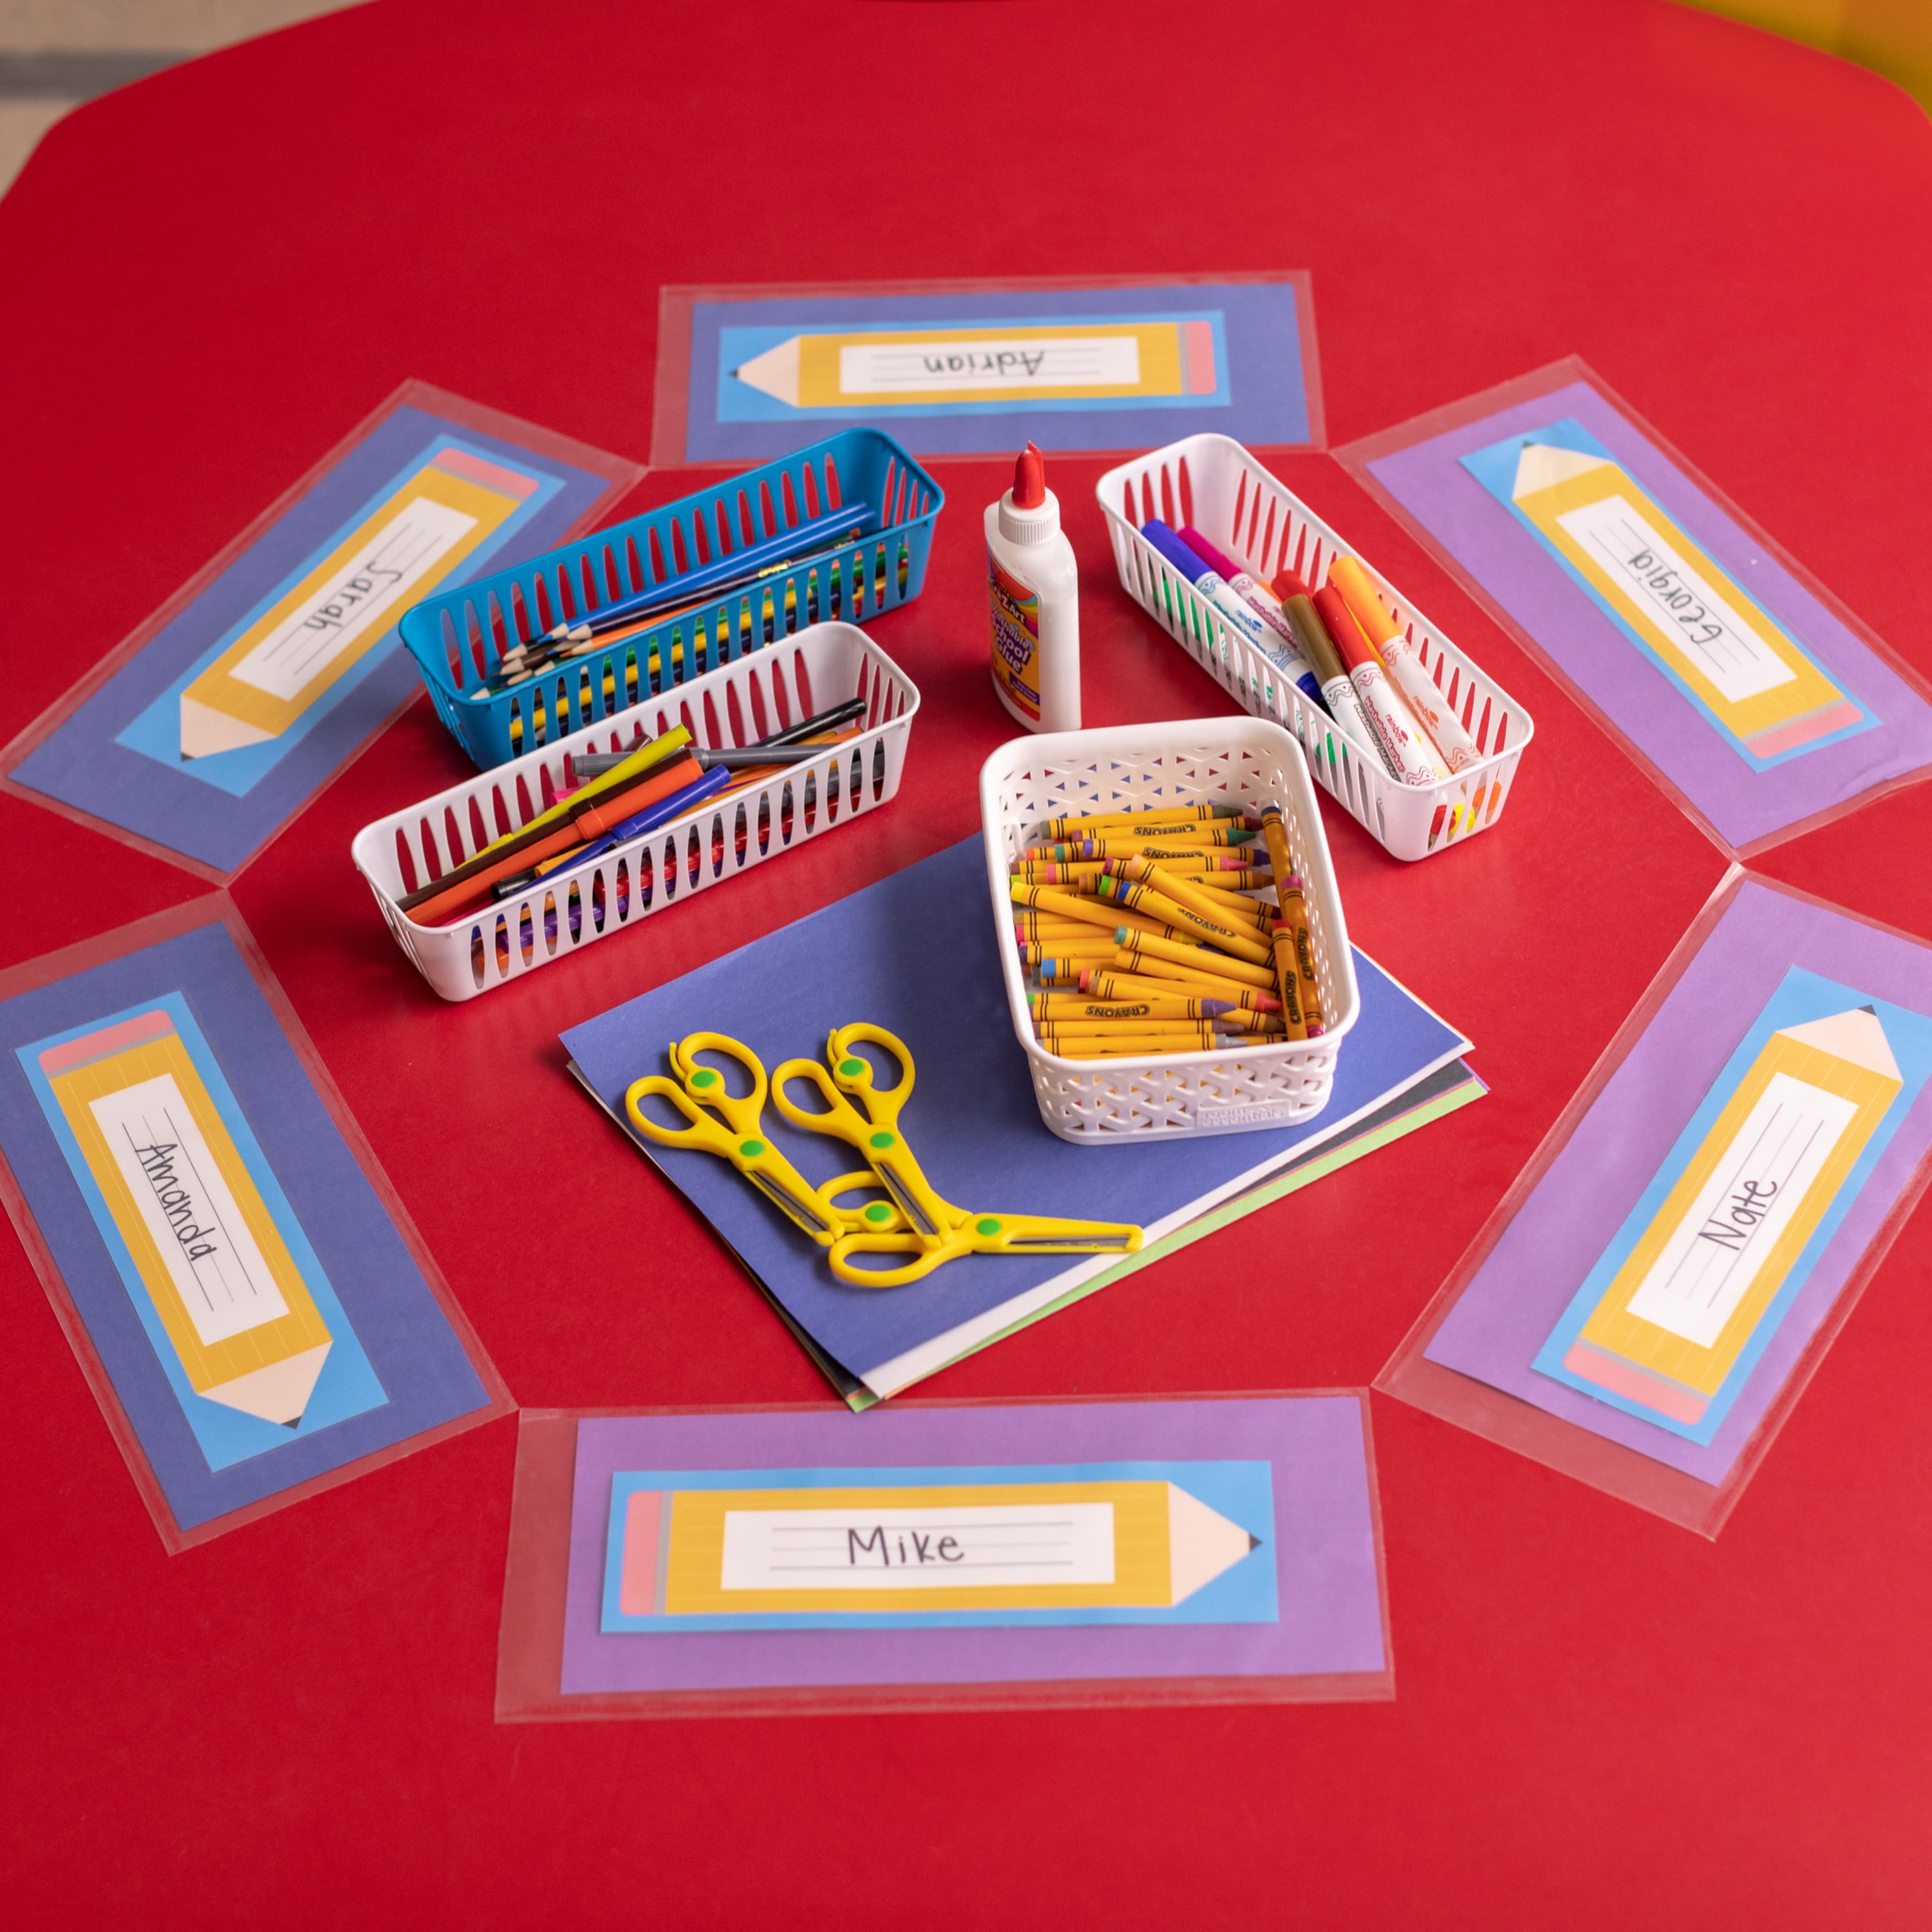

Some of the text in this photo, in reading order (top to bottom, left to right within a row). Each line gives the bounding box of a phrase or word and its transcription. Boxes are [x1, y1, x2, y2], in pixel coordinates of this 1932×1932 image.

[923, 350, 1046, 376] Adrian
[303, 560, 403, 630] Sarah
[1628, 549, 1723, 644] Georgia
[992, 612, 1029, 663] School
[996, 636, 1021, 672] Glue
[1354, 703, 1382, 748] Washable
[1365, 696, 1405, 773] Washable Marker
[1133, 824, 1196, 836] CRAYONS
[1297, 927, 1314, 981] CRAYONS
[1084, 1004, 1150, 1018] CRAYONS
[1285, 971, 1302, 1025] CRAYONS
[135, 1144, 218, 1262] Amanda
[1698, 1180, 1777, 1251] Nate
[848, 1526, 965, 1567] Mike
